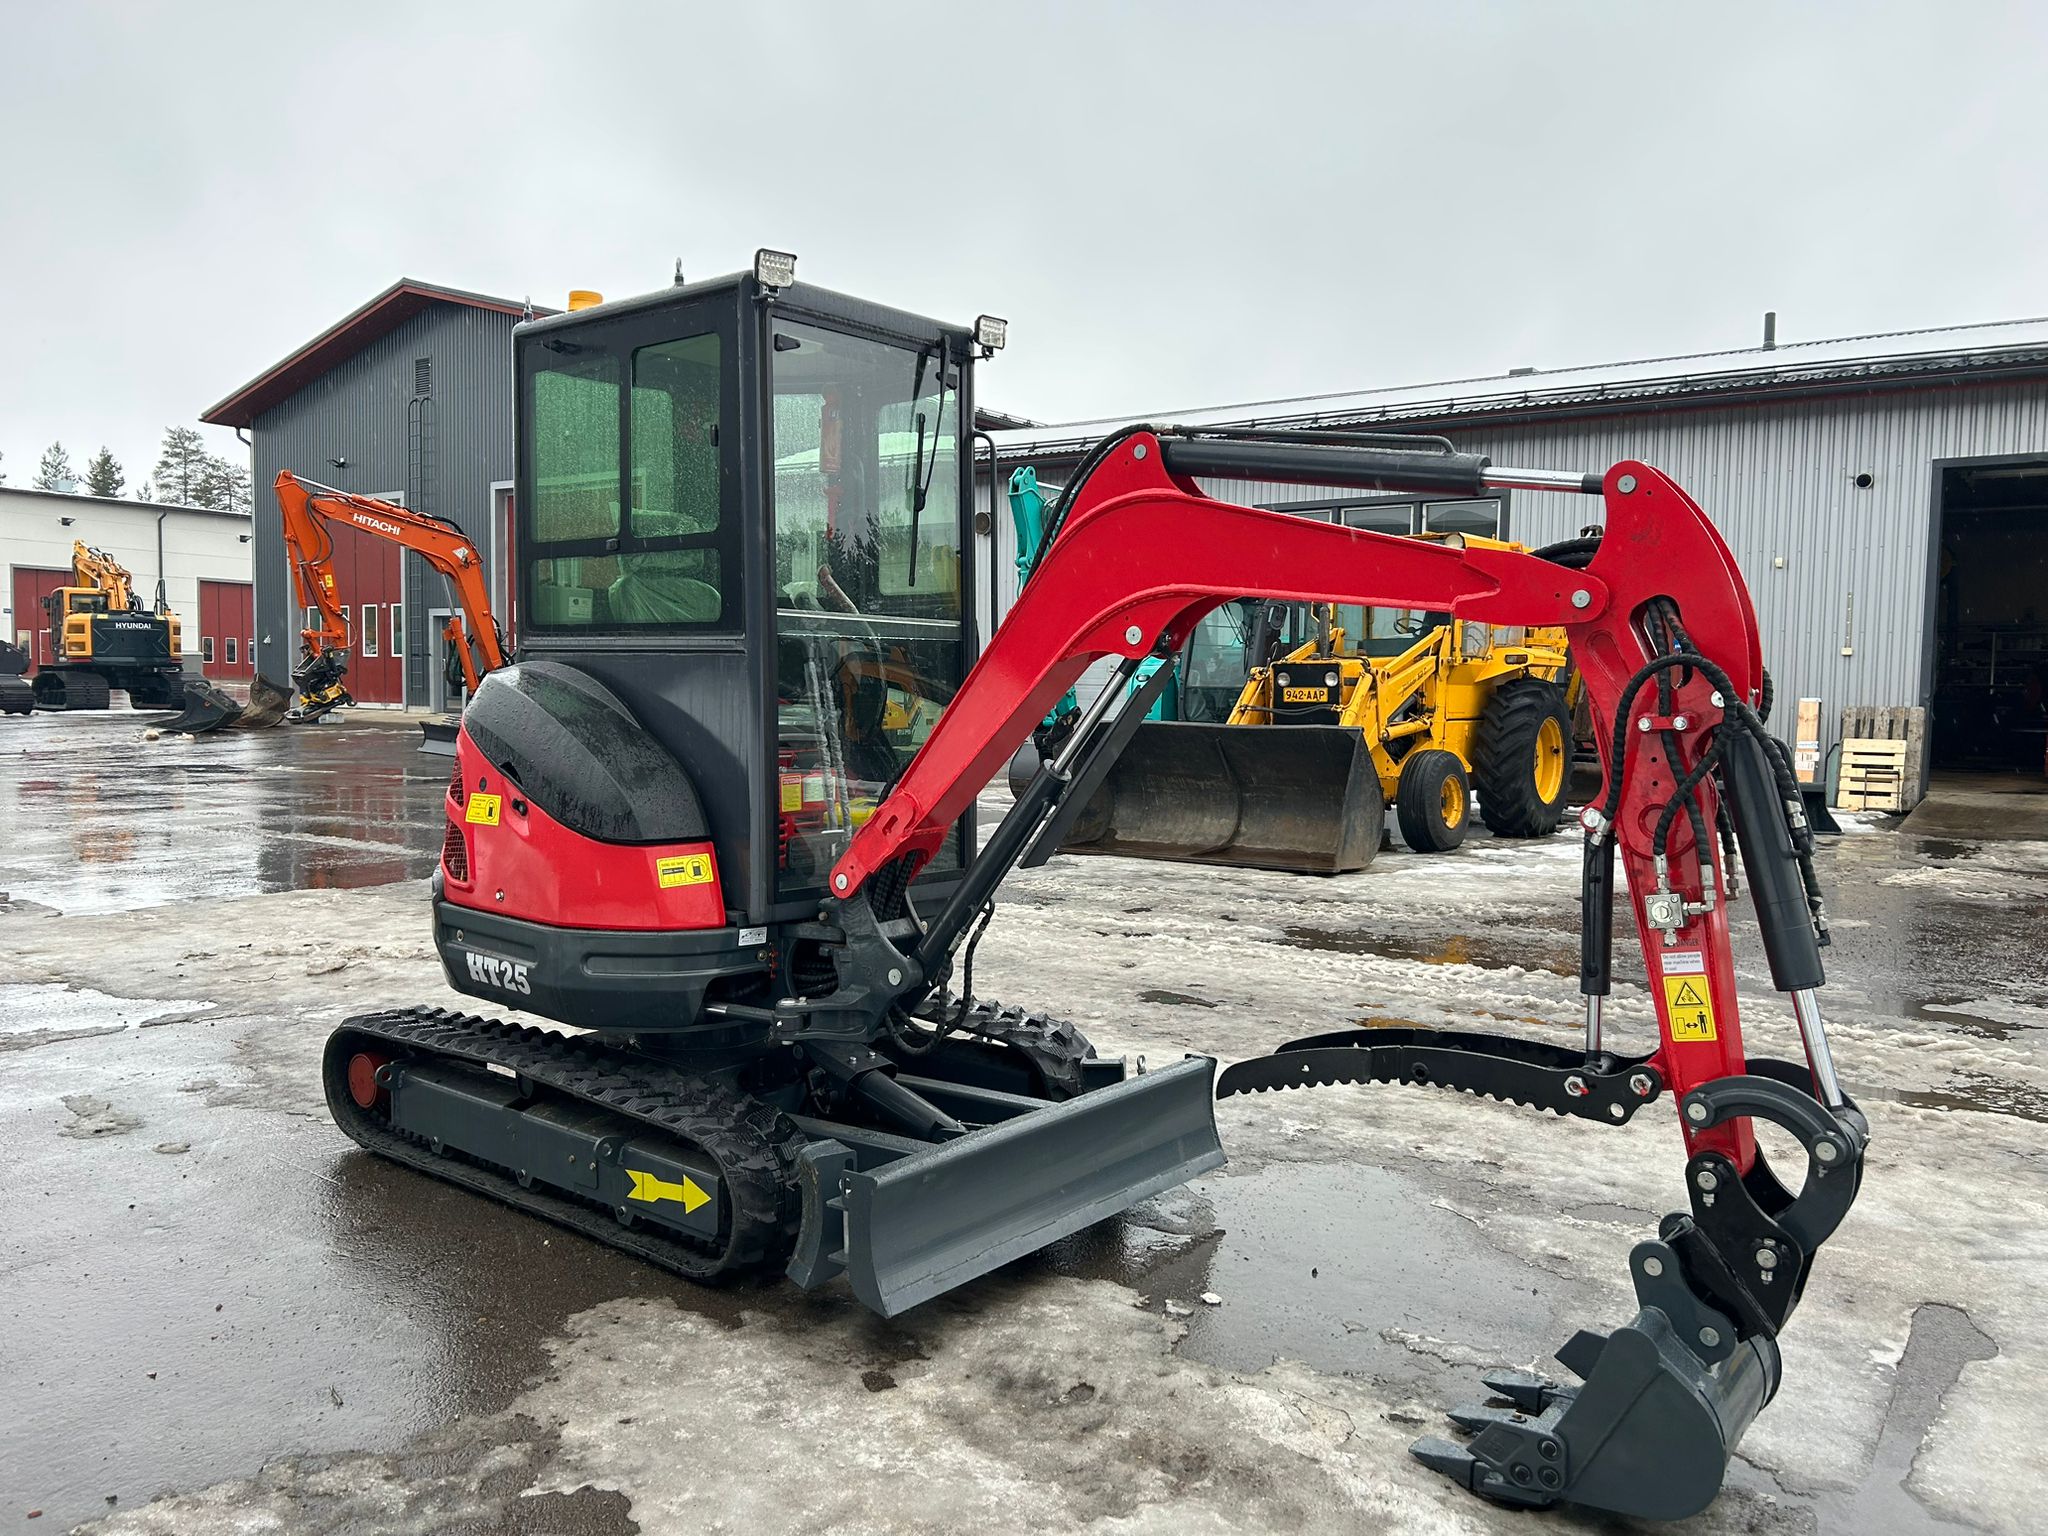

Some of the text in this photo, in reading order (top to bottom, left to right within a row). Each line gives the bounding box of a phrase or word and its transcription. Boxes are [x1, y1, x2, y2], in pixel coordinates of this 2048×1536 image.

[353, 512, 401, 536] HITACHI
[1285, 690, 1325, 700] 942-AAP
[466, 952, 531, 995] HT25
